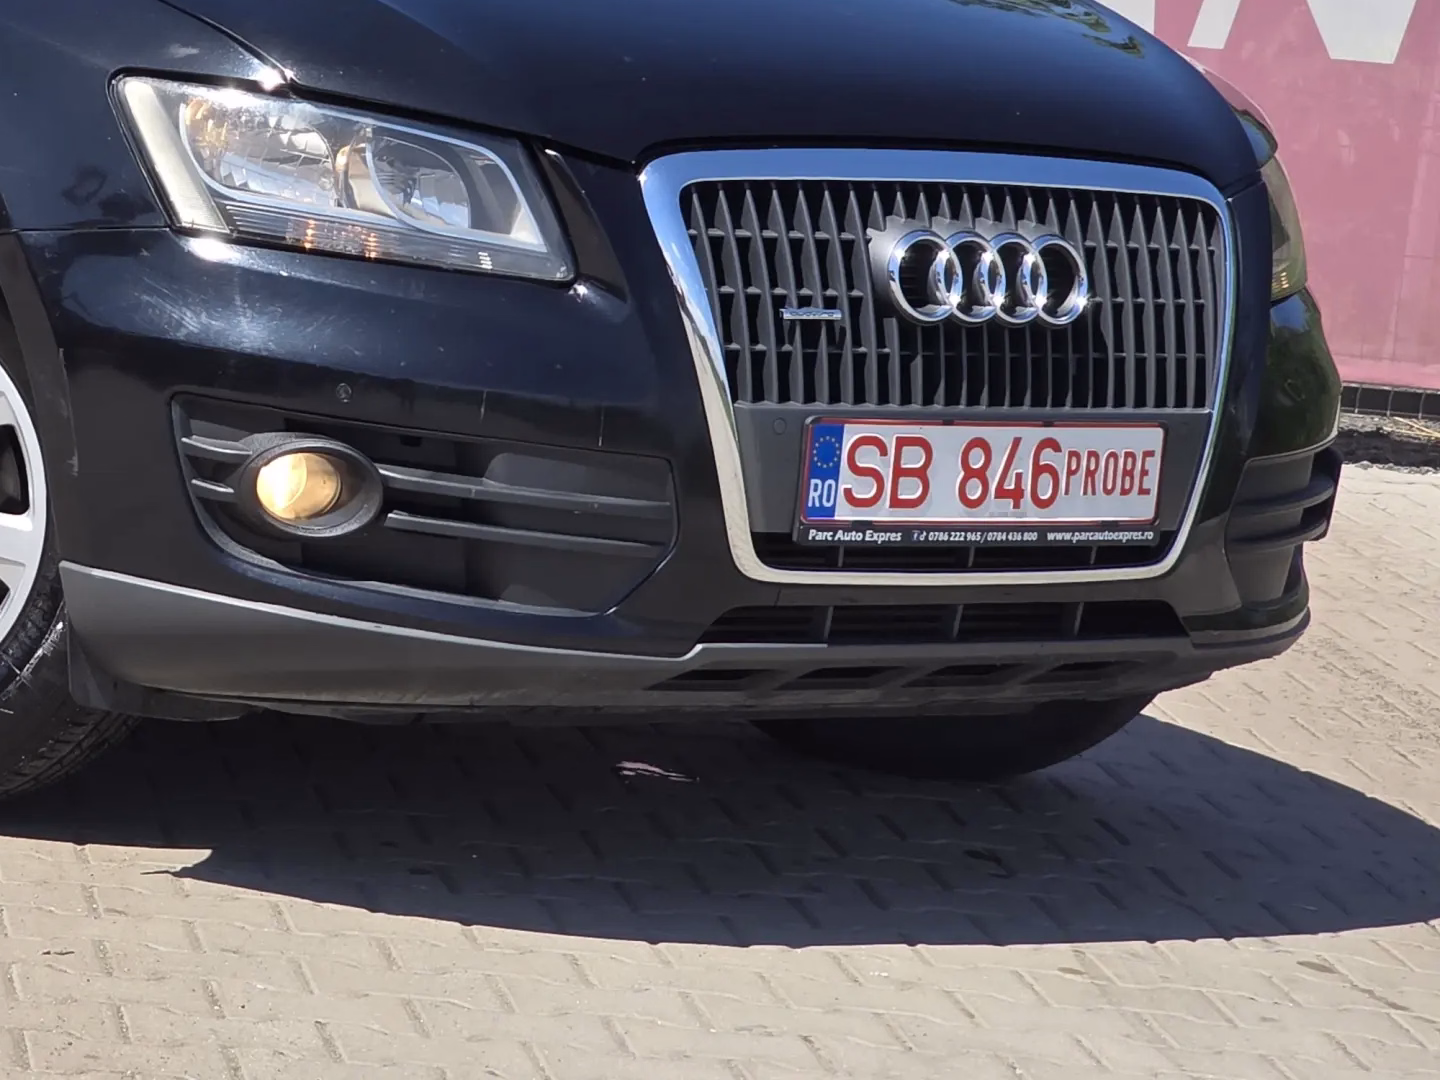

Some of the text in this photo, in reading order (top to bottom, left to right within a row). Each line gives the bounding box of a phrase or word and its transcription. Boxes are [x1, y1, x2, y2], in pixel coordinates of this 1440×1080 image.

[842, 435, 1155, 509] SB 846 PROBE
[808, 479, 836, 507] RO
[808, 529, 833, 540] Parc
[834, 529, 863, 541] Auto
[865, 530, 902, 544] Expres
[1047, 530, 1154, 544] www.parcautoexpres.ro
